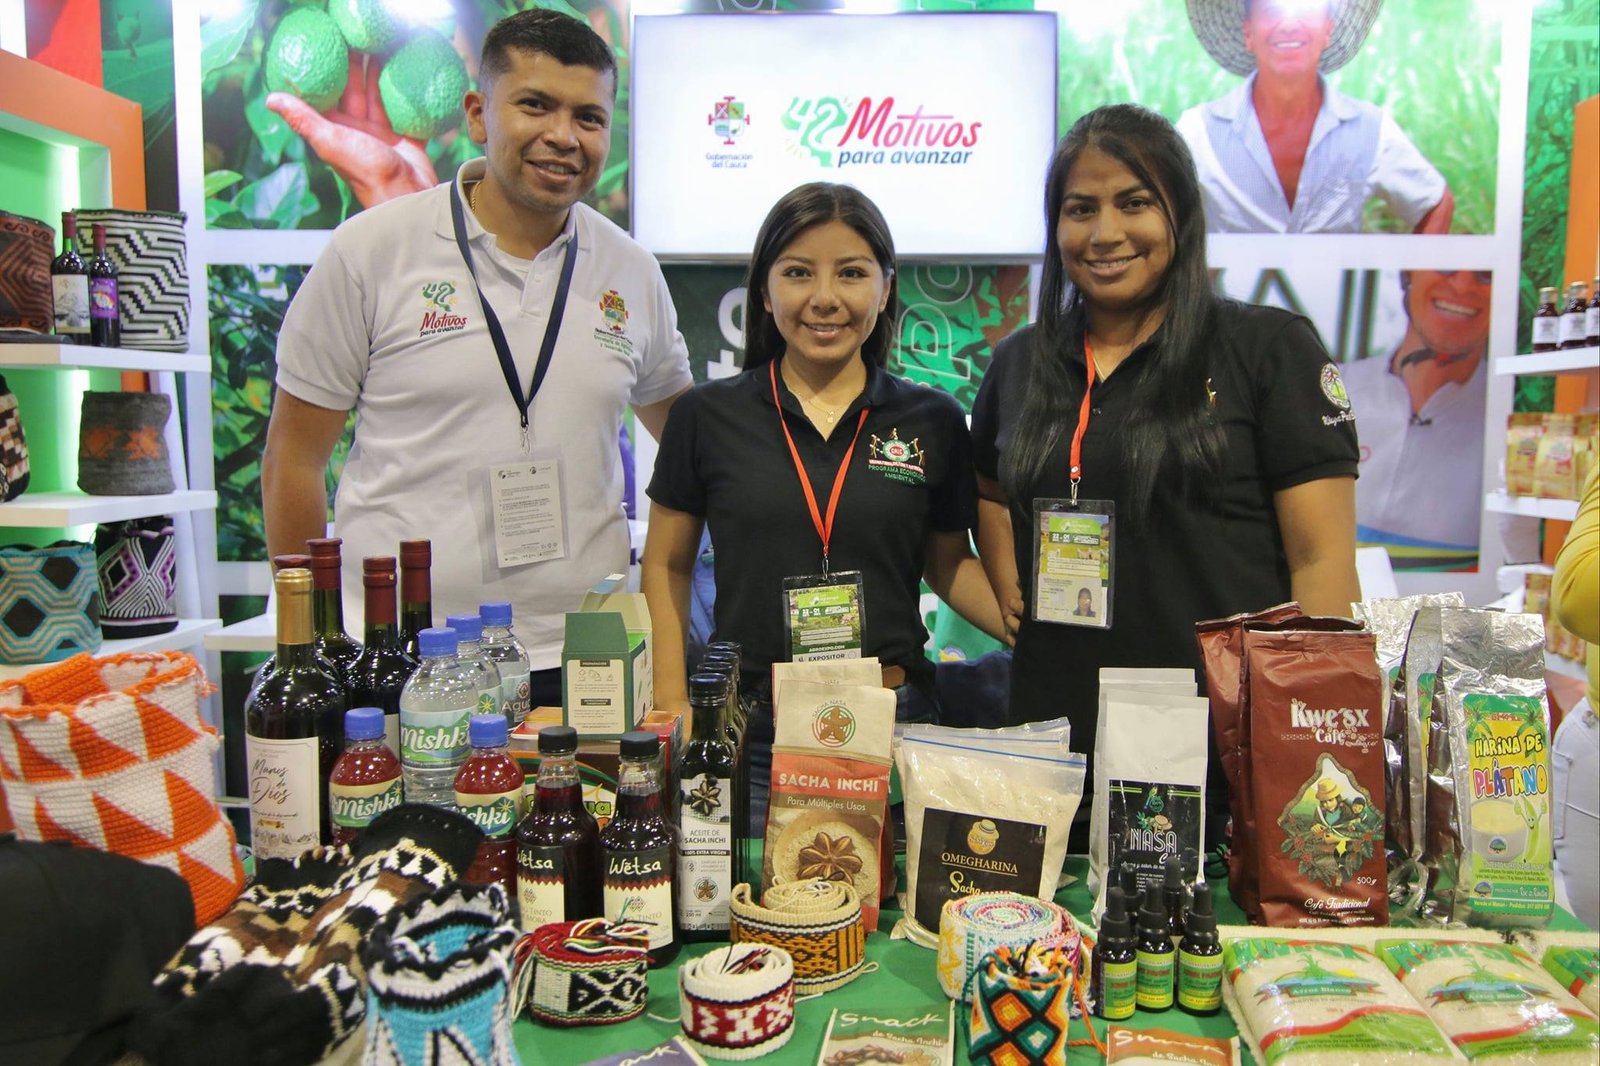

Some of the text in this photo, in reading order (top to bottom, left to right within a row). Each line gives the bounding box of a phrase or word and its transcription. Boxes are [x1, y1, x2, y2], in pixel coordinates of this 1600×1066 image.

[837, 96, 982, 148] Motivos
[711, 160, 724, 168] del
[838, 149, 973, 168] para avanzar
[420, 311, 468, 331] Motivos
[808, 653, 845, 662] EXPOSITOR
[502, 700, 530, 713] Agu
[1315, 728, 1346, 745] Café
[1474, 733, 1543, 758] HARINA DE
[251, 776, 292, 805] Dios
[779, 772, 879, 793] SACHA INCHI
[335, 793, 401, 819] Mishki
[787, 795, 867, 812] Para Múltiples Usos
[1130, 828, 1177, 854] NASA
[941, 852, 1018, 874] OMEGHARINA
[949, 870, 981, 895] Sacha
[1356, 876, 1377, 886] 500g
[1304, 896, 1371, 910] Café Tradicional
[530, 908, 553, 918] TINTO
[638, 911, 662, 921] TINTO
[840, 1013, 945, 1028] Snack
[886, 1033, 914, 1043] Sacha
[1166, 1053, 1198, 1064] Sacha
